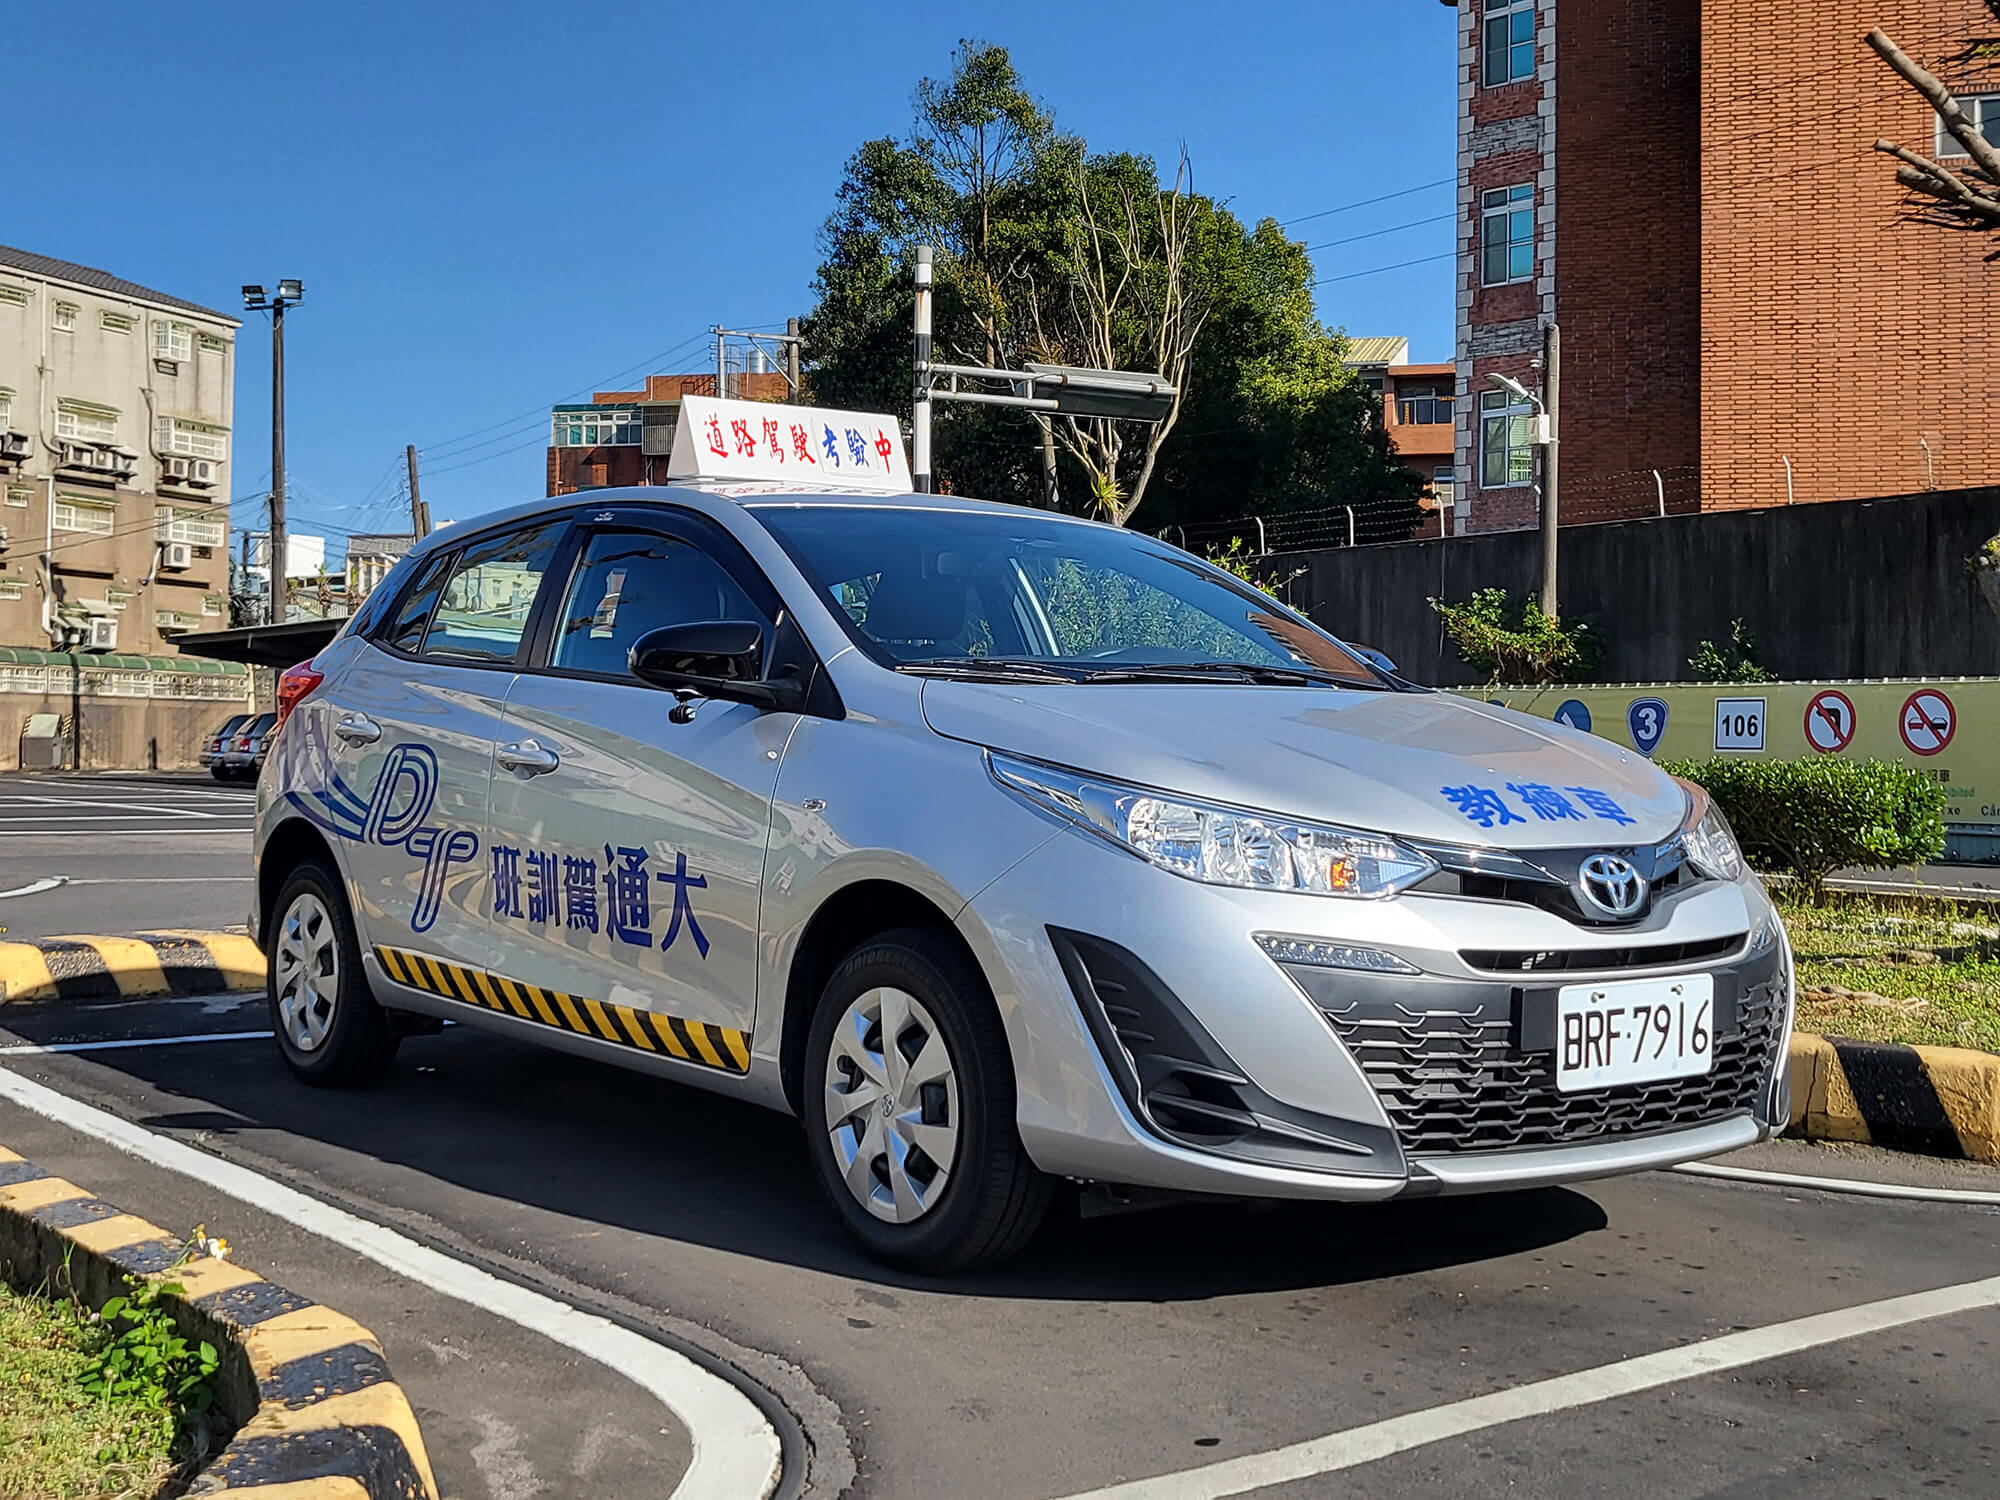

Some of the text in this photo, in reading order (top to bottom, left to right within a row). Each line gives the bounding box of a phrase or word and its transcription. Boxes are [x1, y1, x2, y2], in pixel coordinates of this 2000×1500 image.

[1637, 707, 1658, 740] 3
[1722, 714, 1758, 737] 106
[1440, 782, 1637, 828] 教練車
